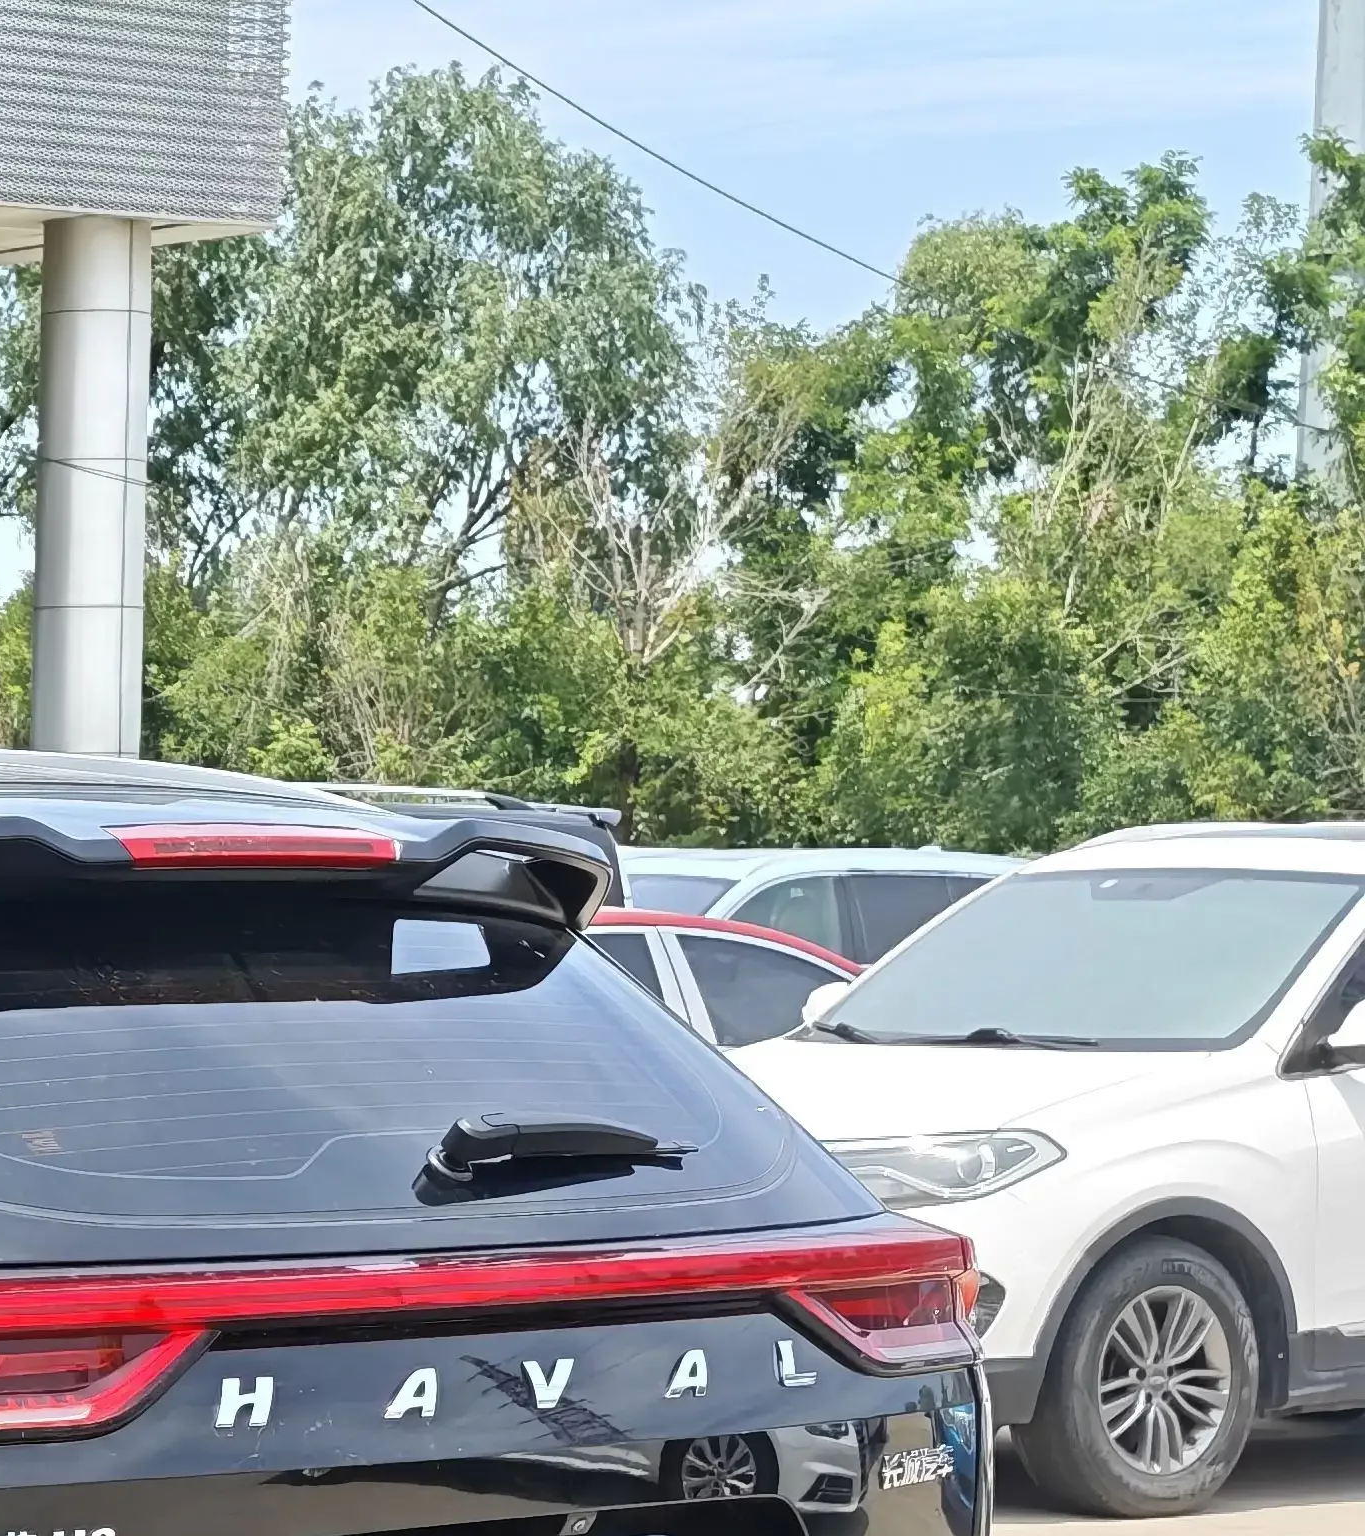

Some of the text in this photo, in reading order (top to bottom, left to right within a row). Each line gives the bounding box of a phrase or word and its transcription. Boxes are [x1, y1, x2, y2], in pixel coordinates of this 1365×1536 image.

[214, 1339, 819, 1428] HAVAL
[881, 1443, 955, 1491] 长城汽车
